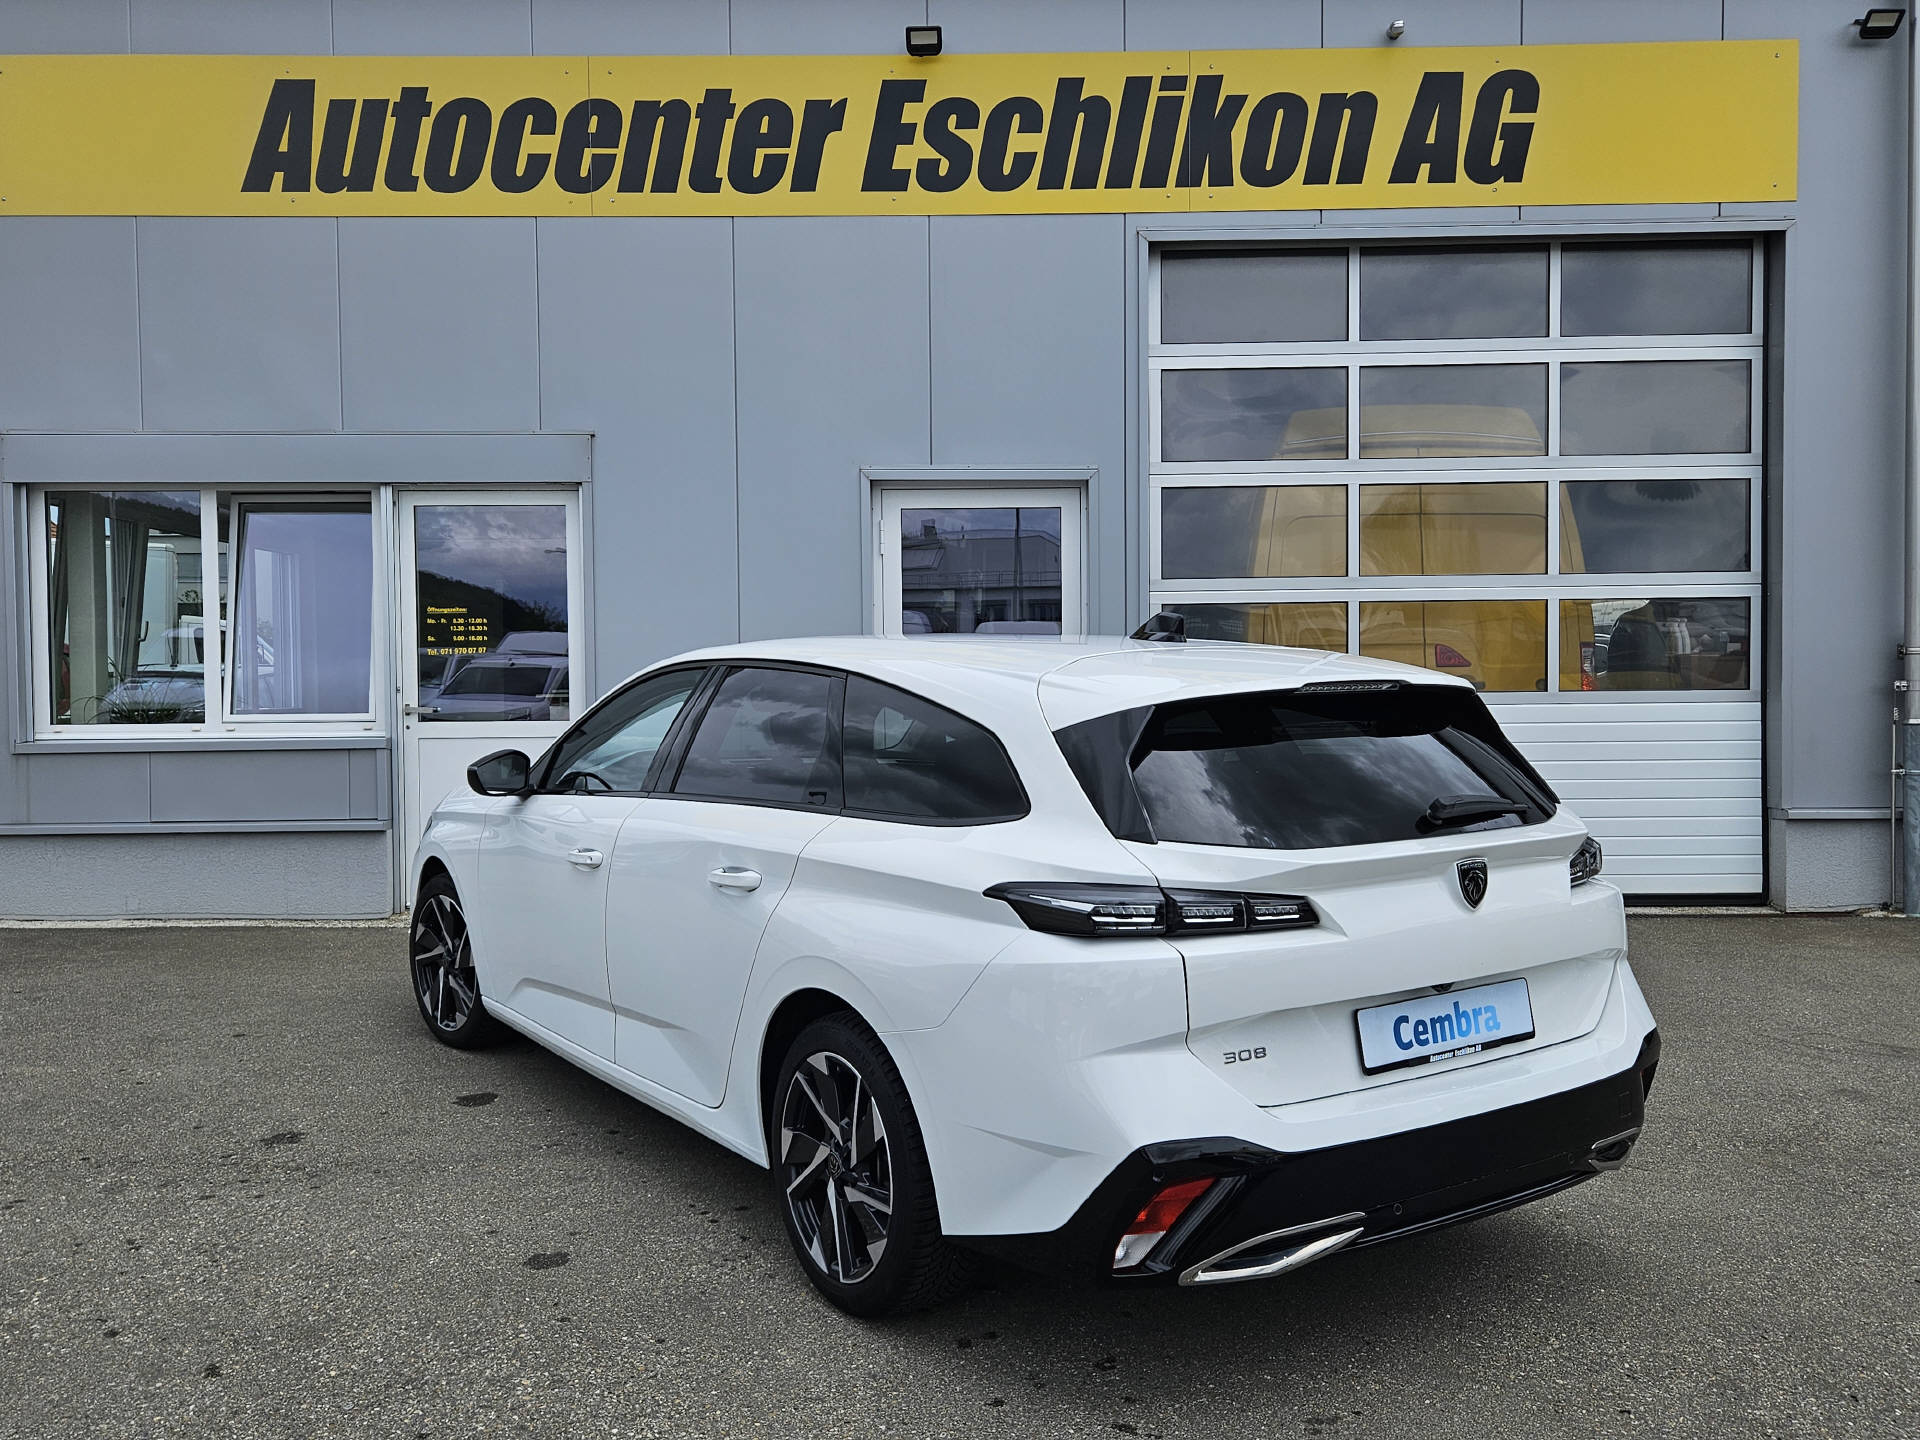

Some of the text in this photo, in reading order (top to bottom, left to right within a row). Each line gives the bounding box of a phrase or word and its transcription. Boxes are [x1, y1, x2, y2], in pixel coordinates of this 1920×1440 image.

[241, 69, 1541, 195] Autocenter Eschlikon AG
[427, 648, 439, 656] Tel.
[454, 647, 467, 655] 970
[1393, 1001, 1501, 1050] Cembra
[1223, 1047, 1267, 1065] 308
